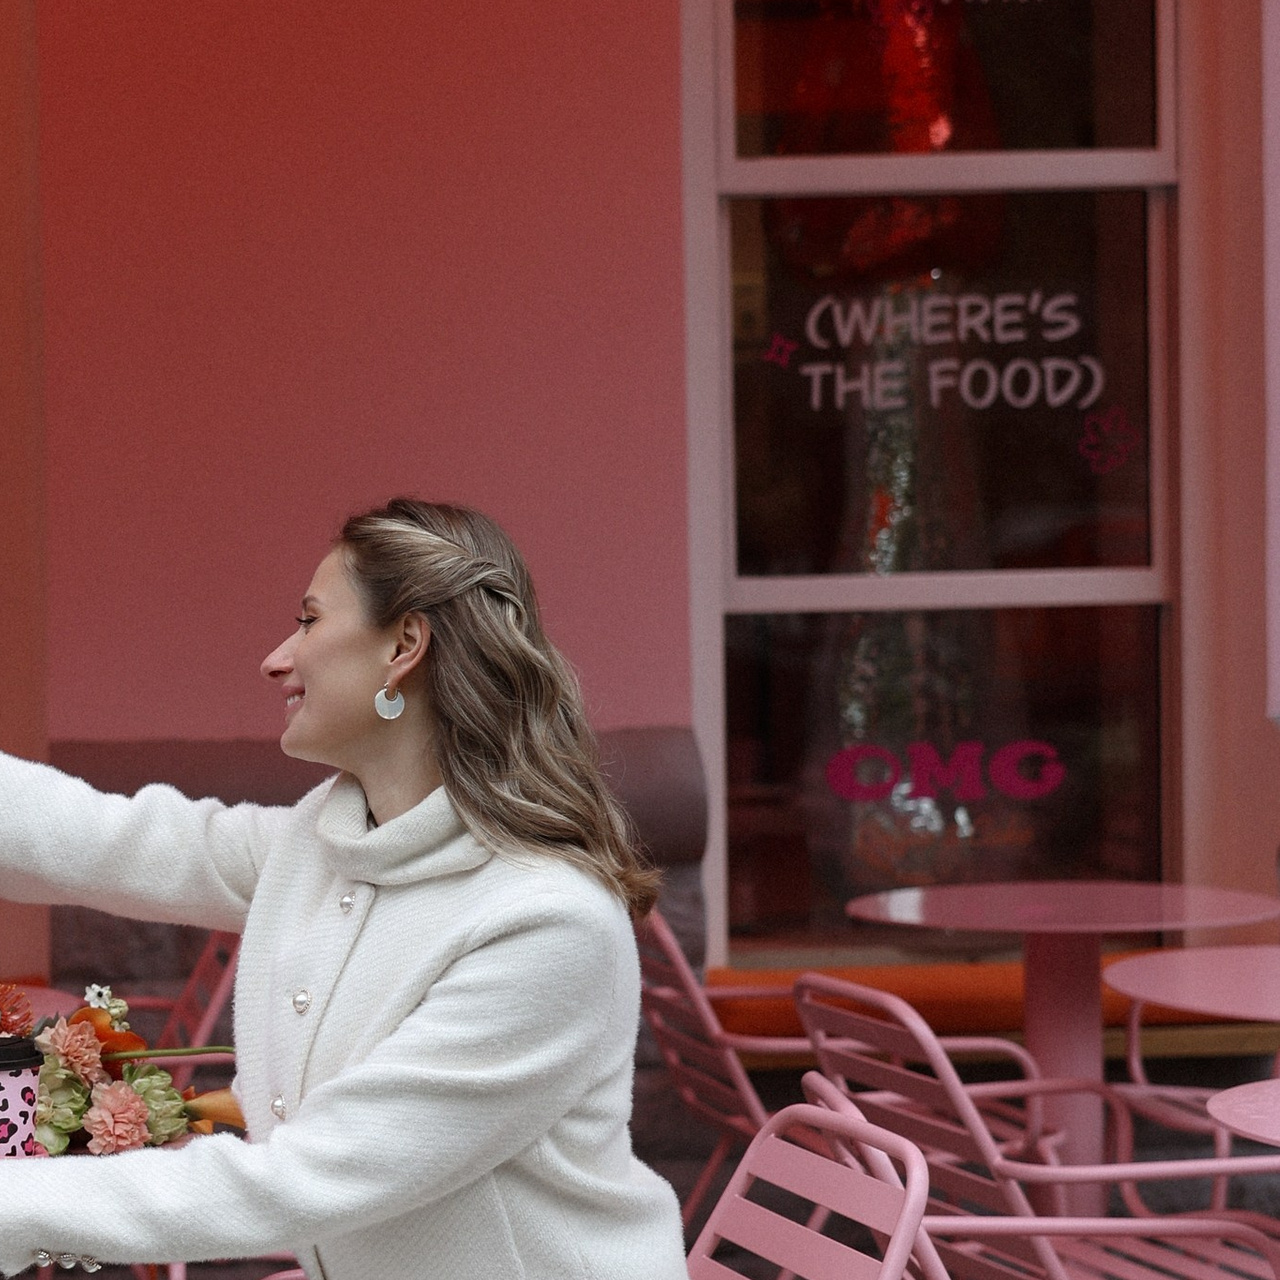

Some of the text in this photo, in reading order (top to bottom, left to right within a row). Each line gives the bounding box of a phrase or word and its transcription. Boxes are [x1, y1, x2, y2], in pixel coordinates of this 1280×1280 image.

[805, 290, 1082, 349] (WHERE'S
[800, 355, 1105, 411] THE FOOD)
[825, 739, 1067, 802] OMG
